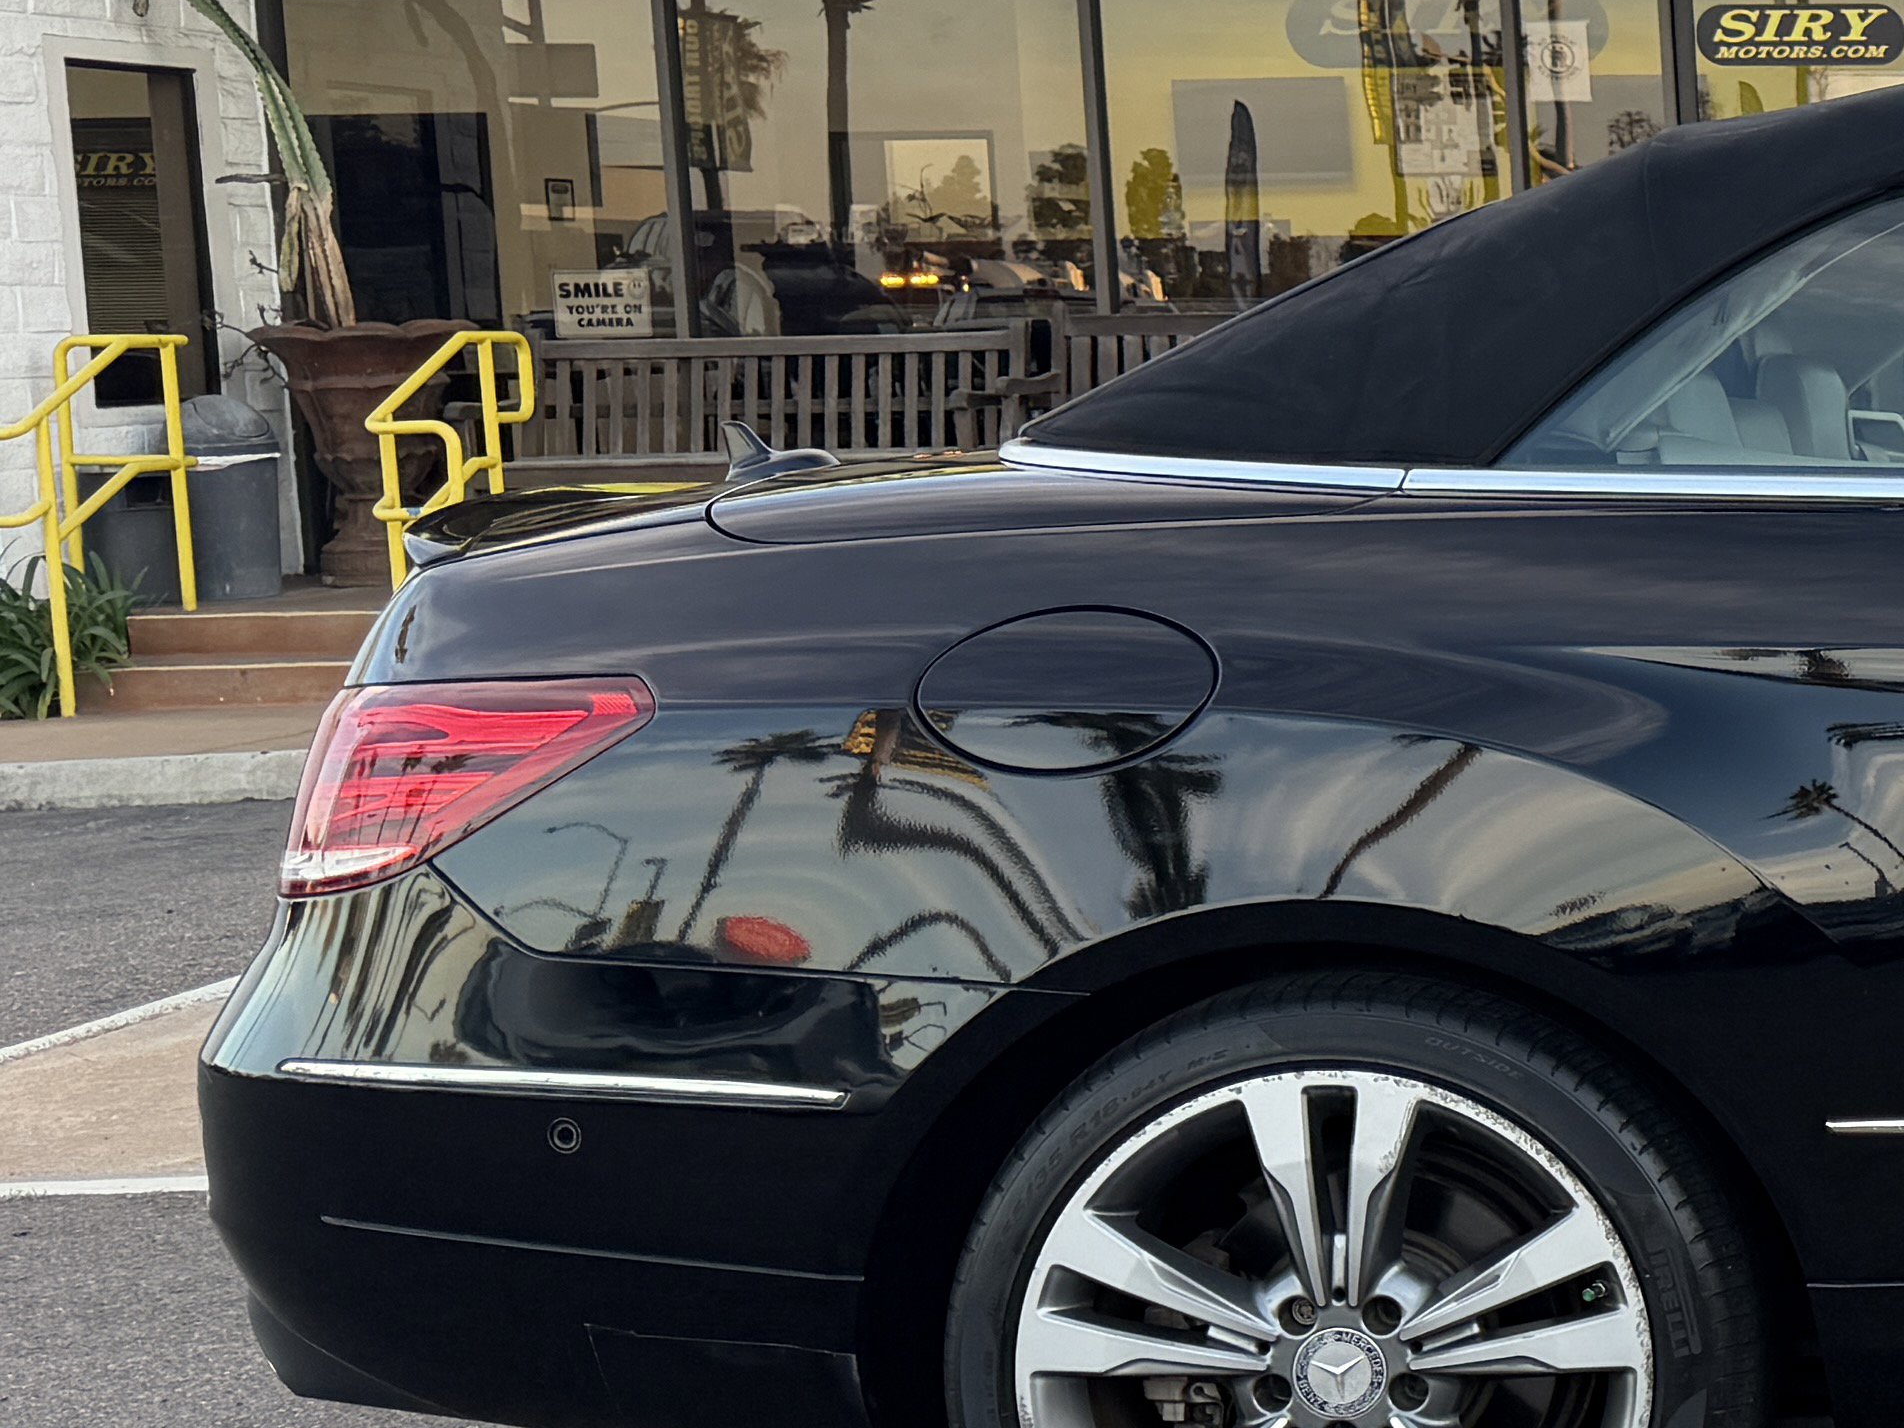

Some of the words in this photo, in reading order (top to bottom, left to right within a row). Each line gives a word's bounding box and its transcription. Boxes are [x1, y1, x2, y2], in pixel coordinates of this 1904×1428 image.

[1712, 8, 1888, 43] SIRY
[1715, 44, 1888, 59] MOTORS.COM
[558, 281, 625, 299] SMILE
[566, 303, 619, 315] YOU'RE
[623, 303, 643, 315] ON
[577, 317, 634, 328] CAMERA
[1423, 1035, 1526, 1081] OUTSIDE
[1644, 1240, 1703, 1359] PIRELLI
